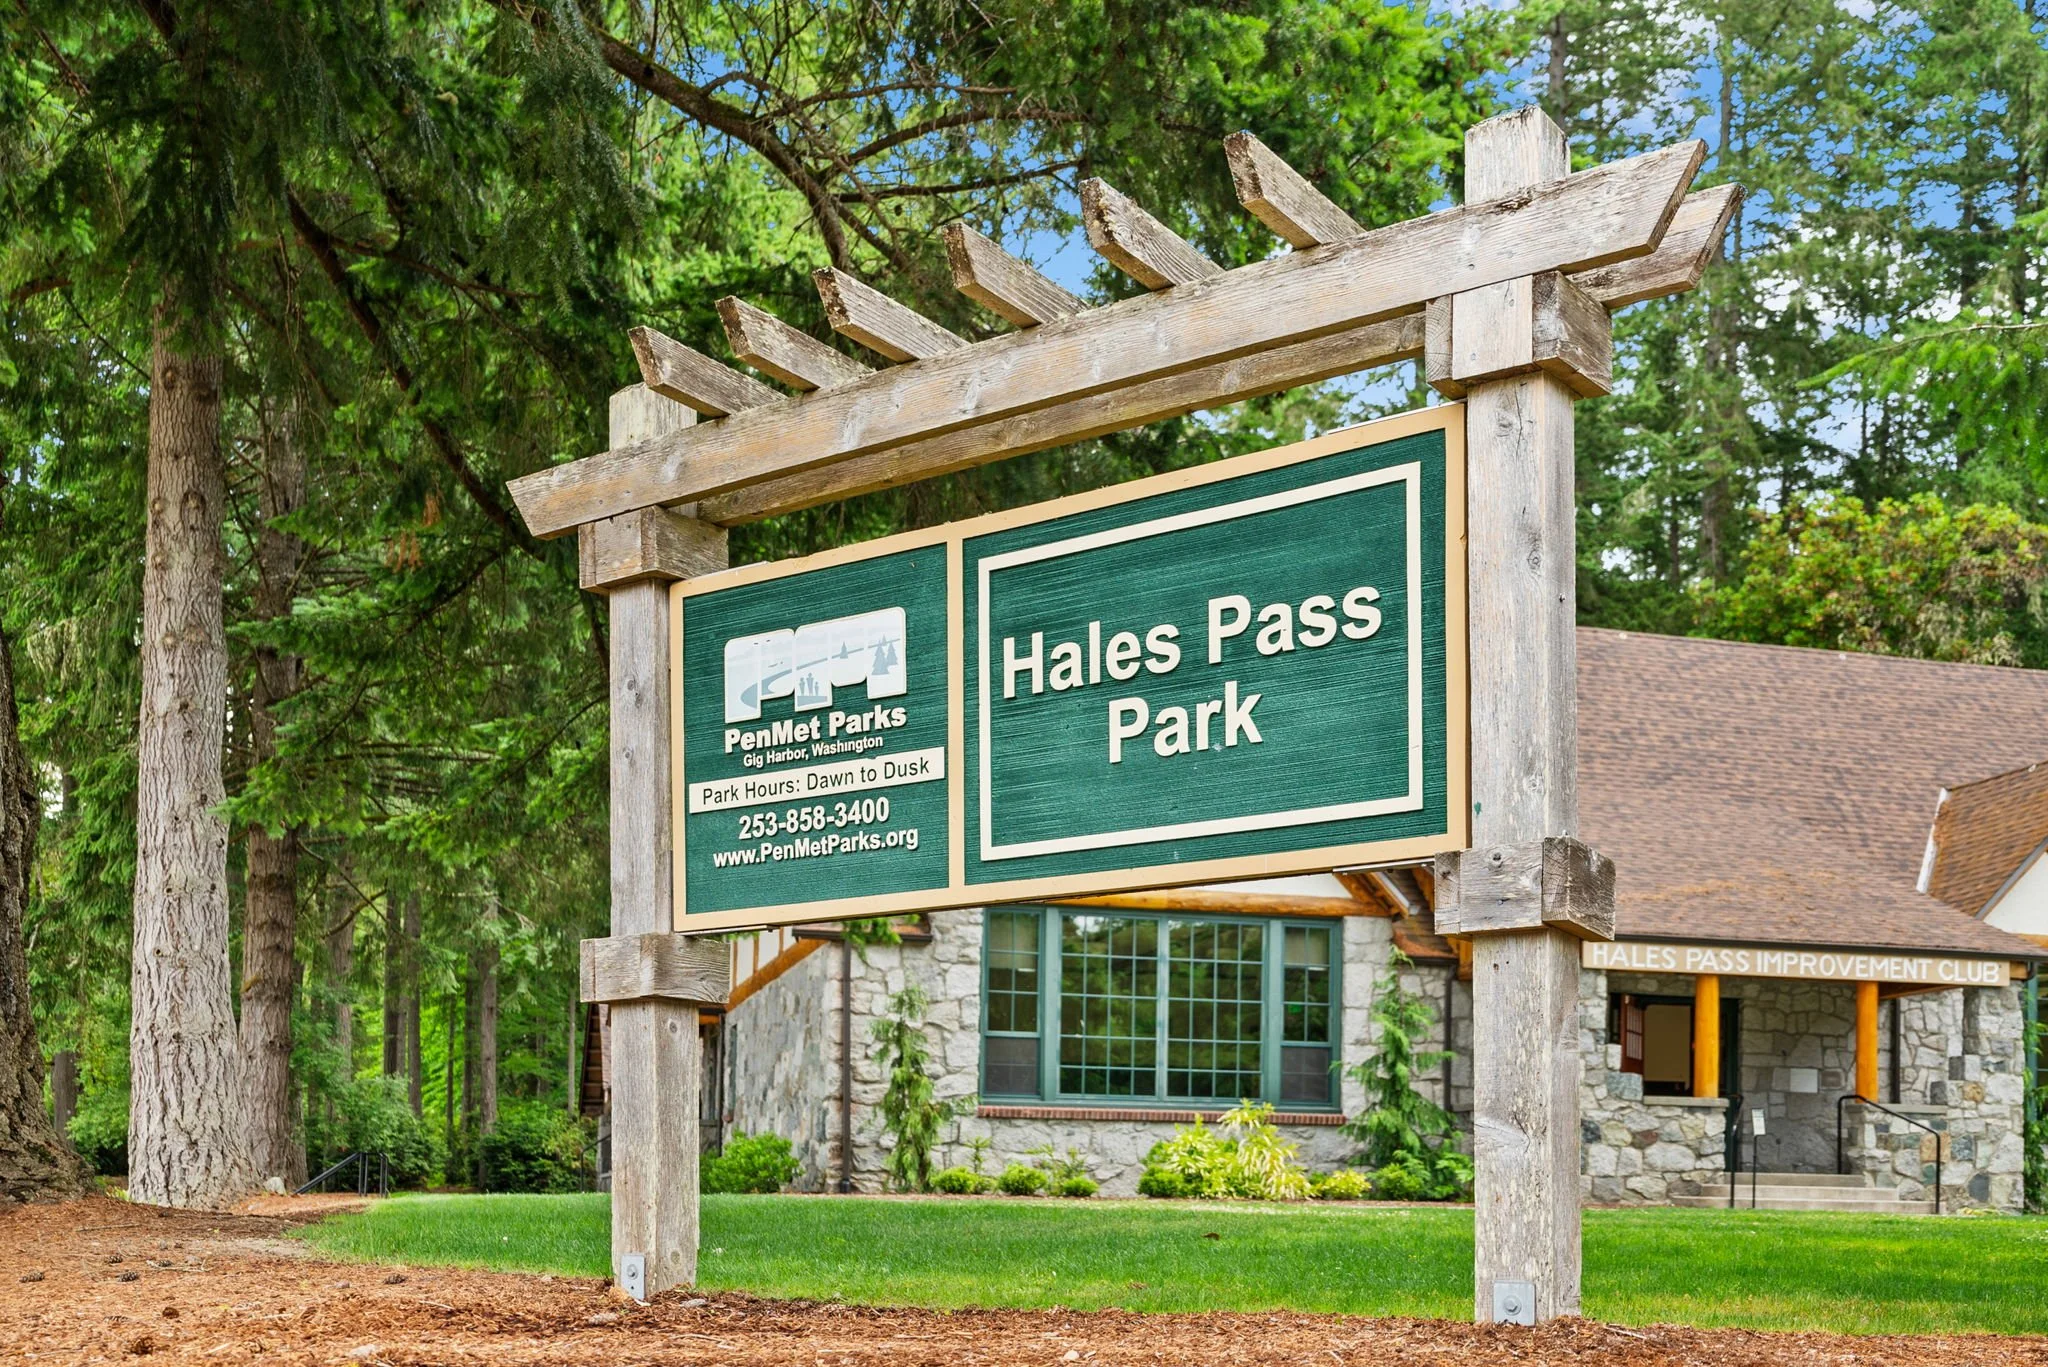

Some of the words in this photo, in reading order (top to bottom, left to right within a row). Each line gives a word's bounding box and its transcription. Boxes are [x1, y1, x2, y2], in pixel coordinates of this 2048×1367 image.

[1003, 620, 1181, 699] Hales
[1208, 586, 1383, 664] Pass
[724, 716, 821, 753] PenMet
[829, 704, 907, 737] Parks
[1109, 681, 1263, 764] Park
[743, 754, 764, 769] Gig
[766, 747, 809, 765] Harbor,
[811, 736, 884, 757] Washington
[703, 784, 739, 805] Park
[745, 777, 800, 799] Hours:
[806, 771, 854, 791] Dawn
[860, 766, 877, 784] to
[884, 757, 930, 780] Dusk
[738, 797, 890, 840] 253-858-3400
[713, 827, 919, 868] www.PenMetParks.org
[1592, 943, 1677, 969] HALES
[1686, 948, 1750, 973] PASS
[1756, 951, 1933, 980] IMPROVEMENT
[1938, 960, 2000, 983] CLUB
